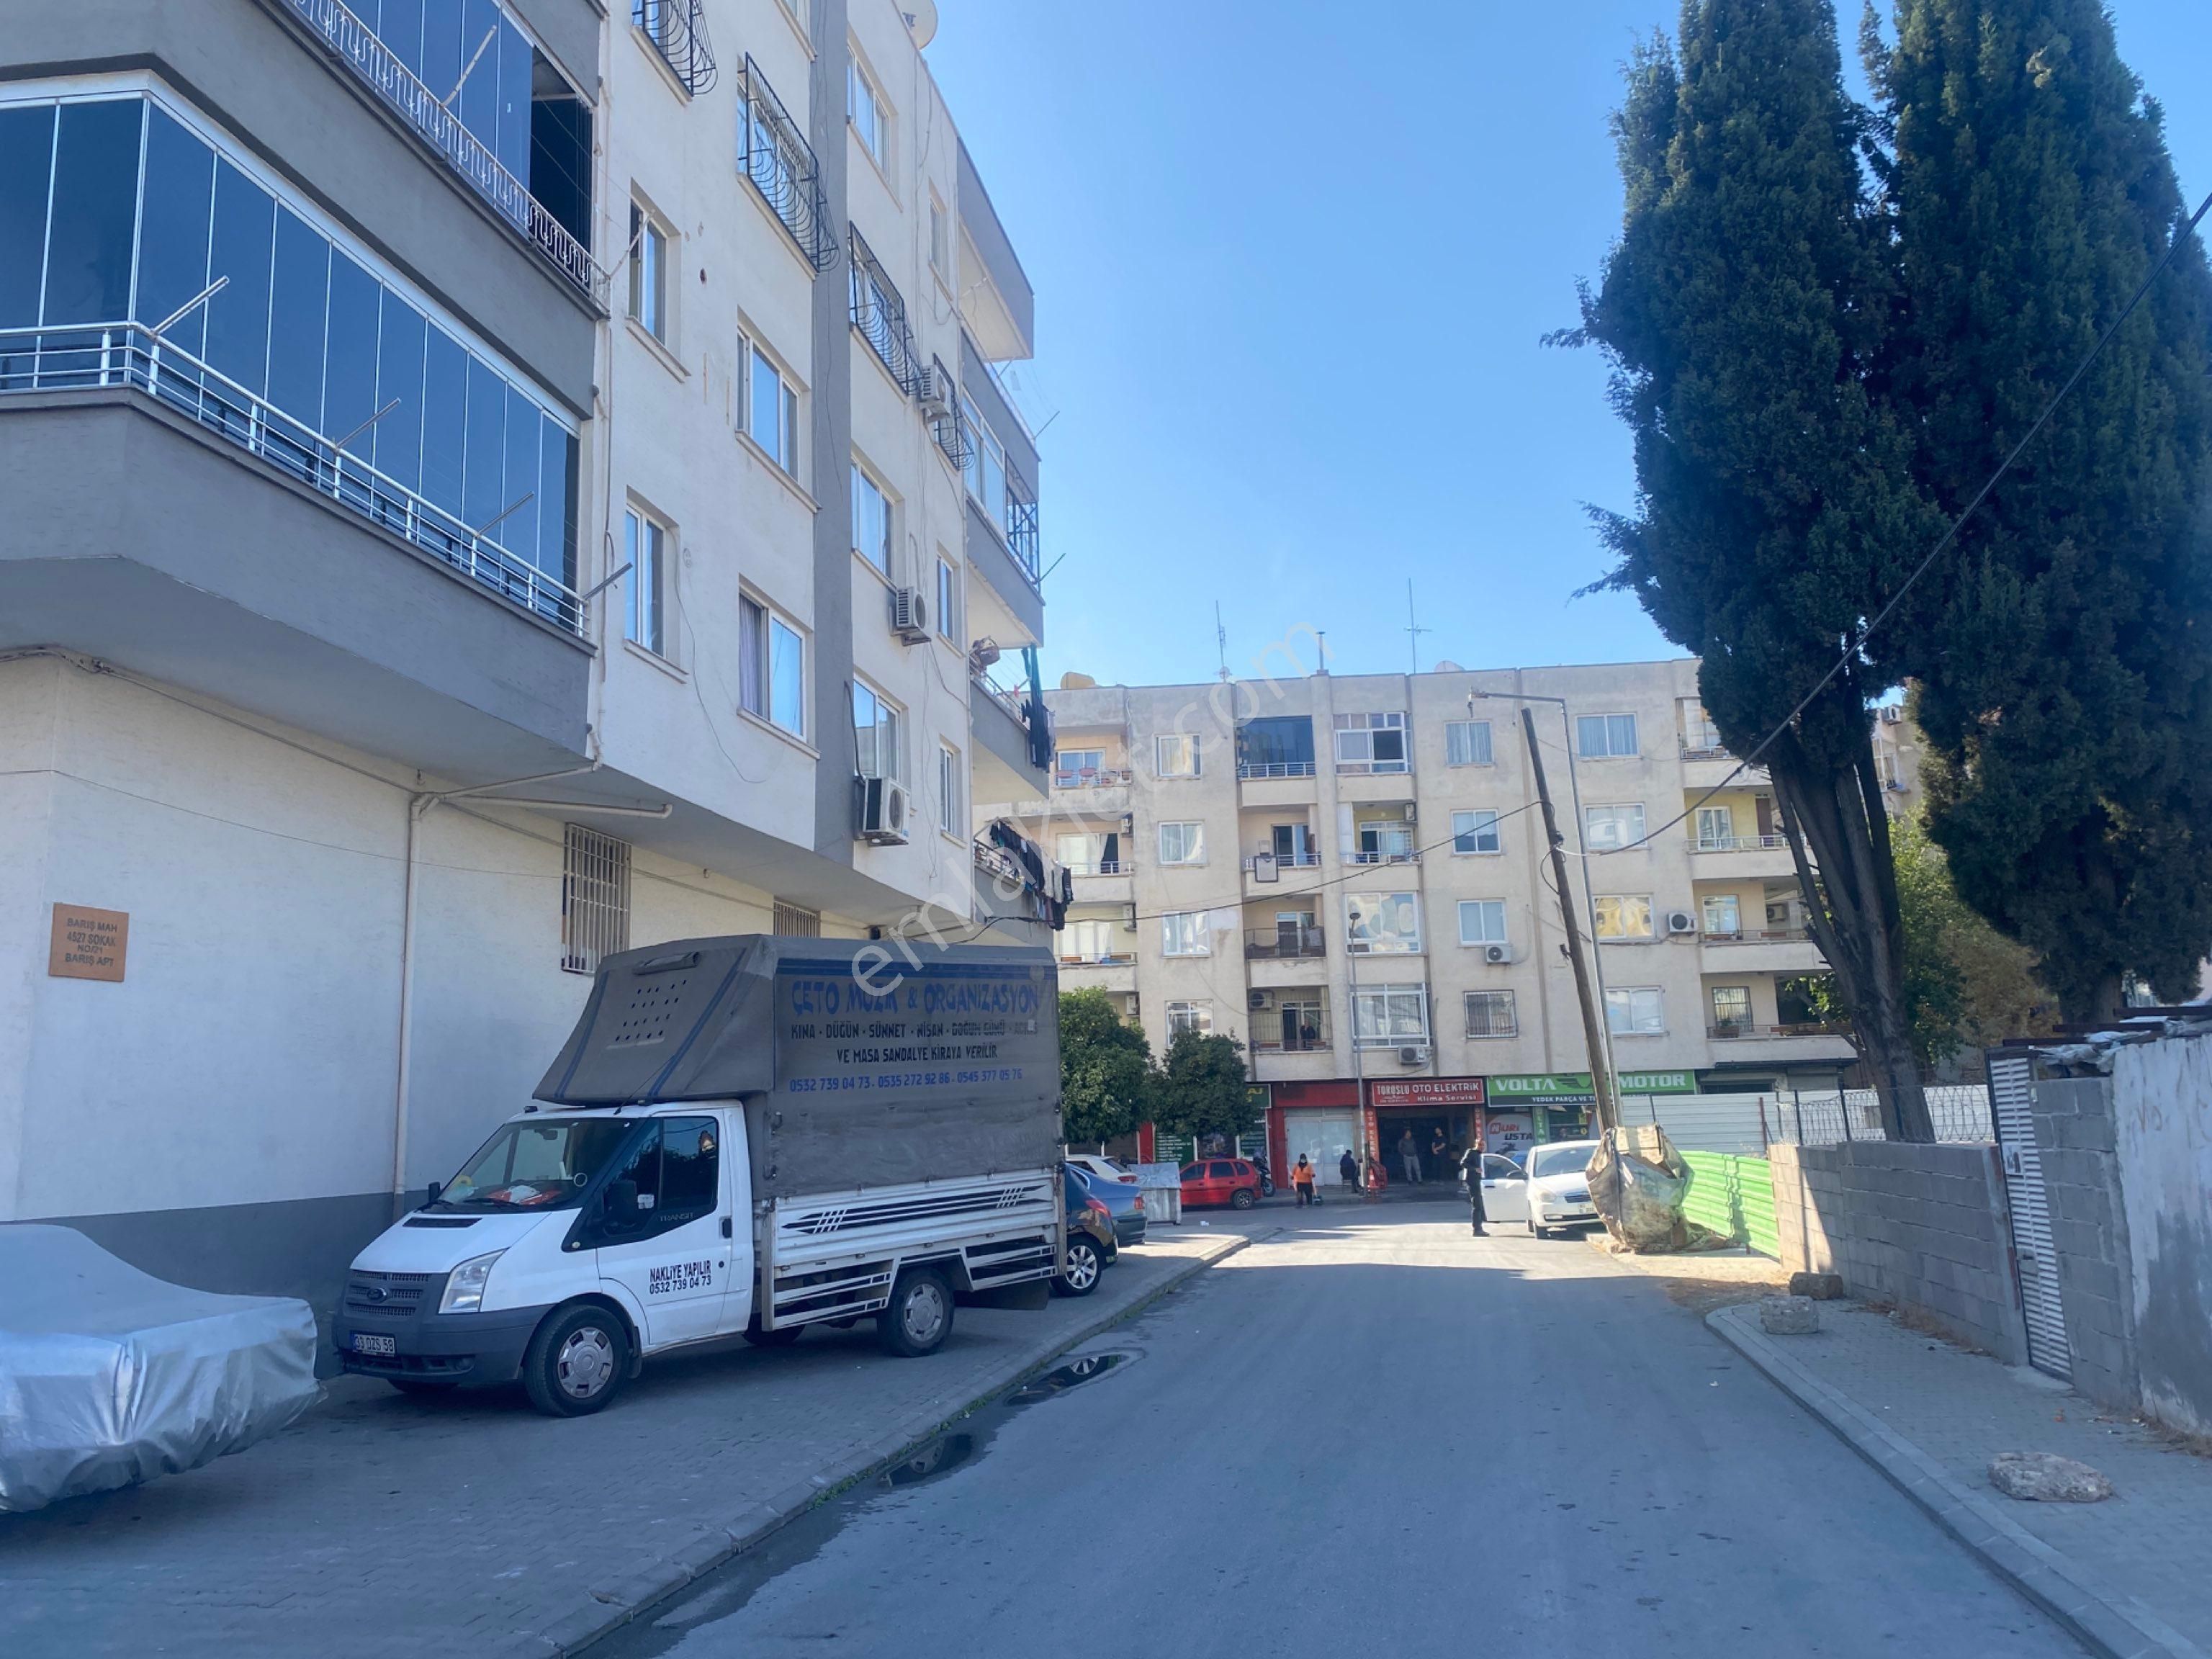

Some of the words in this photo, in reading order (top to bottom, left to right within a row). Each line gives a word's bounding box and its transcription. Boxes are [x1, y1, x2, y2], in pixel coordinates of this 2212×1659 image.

[67, 918, 94, 932] BARIŞ
[97, 922, 117, 932] MAH
[88, 934, 116, 946] SOKAK
[96, 957, 114, 967] APT
[791, 1024, 815, 1039] KINA
[826, 1021, 860, 1038] DÜĞÜN
[868, 1021, 906, 1038] SÜNNET
[837, 1049, 850, 1064] VE
[853, 1048, 879, 1063] MASA
[883, 1047, 927, 1062] SANDALYE
[931, 1045, 961, 1060] KİRAYA
[966, 1043, 997, 1059] VERİLİR
[790, 1078, 817, 1092] 0532
[819, 1077, 839, 1091] 739
[842, 1076, 855, 1090] 04
[858, 1076, 870, 1089] 73
[878, 1075, 902, 1088] 0535
[904, 1074, 922, 1087] 272
[925, 1073, 936, 1086] 92
[957, 1071, 979, 1083] 0545
[981, 1070, 997, 1082] 377
[1413, 1084, 1431, 1093] OTO
[1496, 1077, 1556, 1092] VOLTA
[1619, 1074, 1686, 1089] MOTOR
[1555, 1095, 1577, 1104] PARÇA
[683, 1260, 711, 1277] YAPILIR
[649, 1282, 670, 1295] 0532
[673, 1279, 687, 1291] 739
[690, 1277, 699, 1288] 04
[701, 1274, 711, 1286] 73
